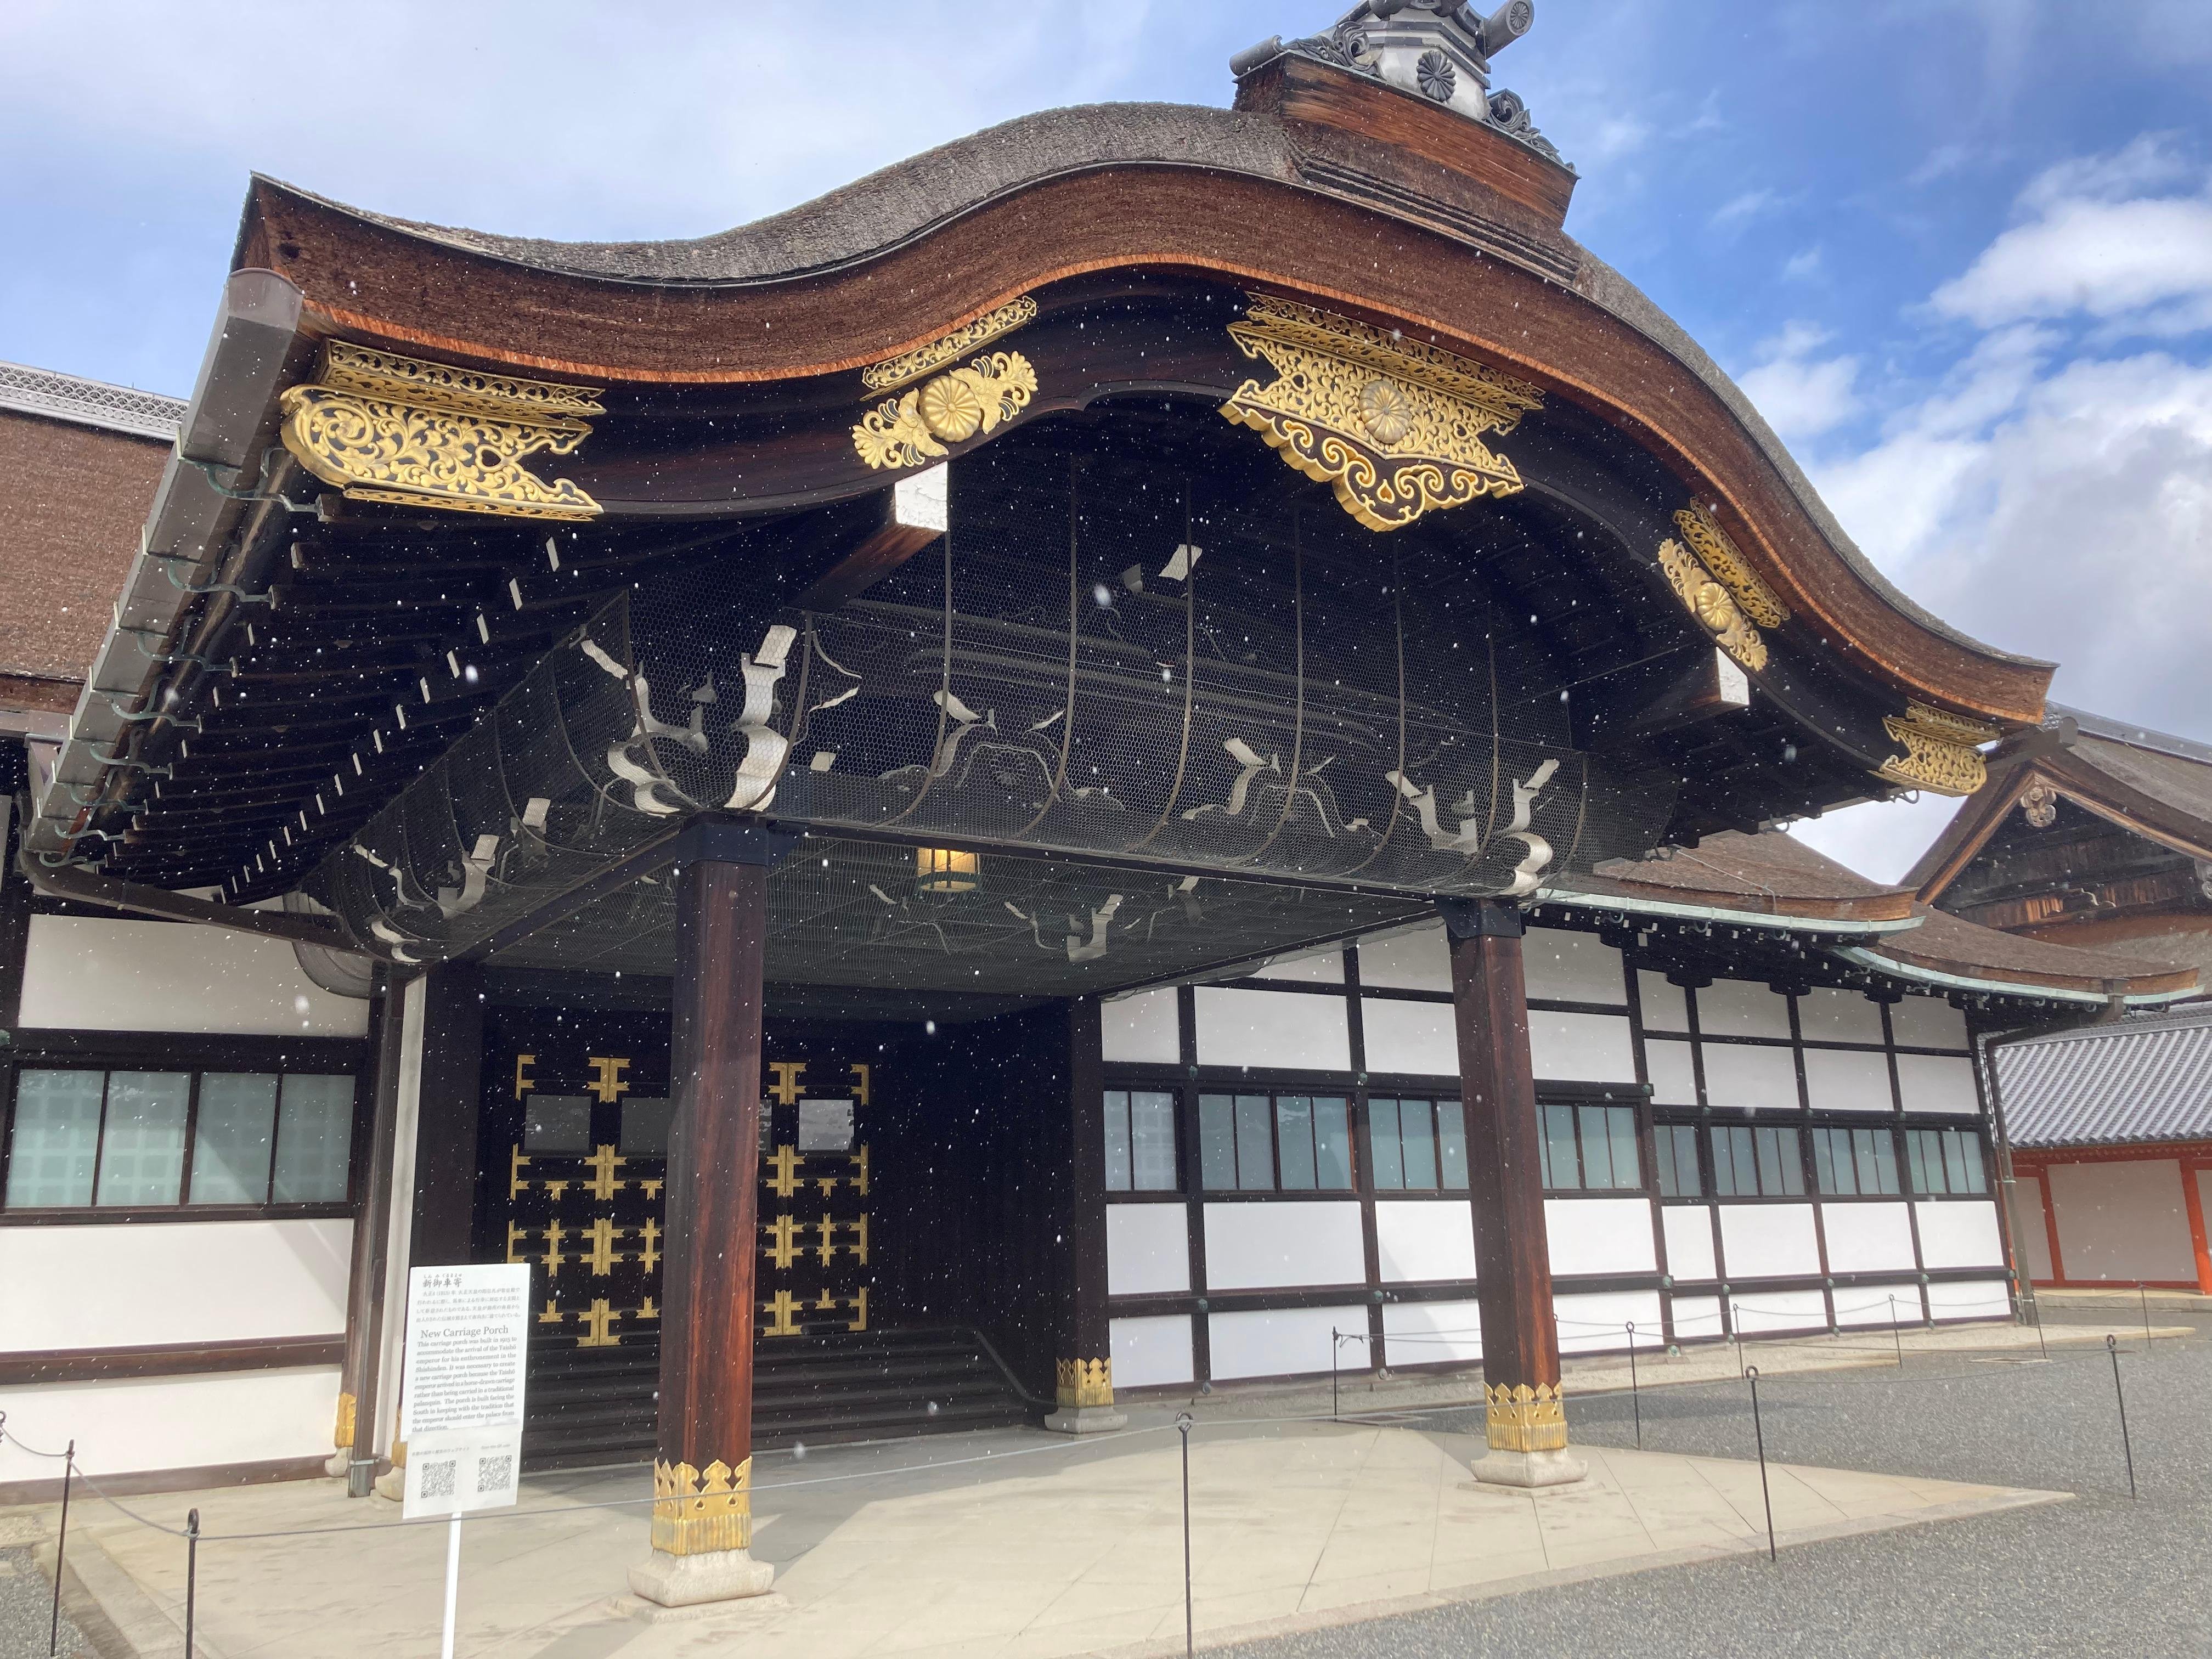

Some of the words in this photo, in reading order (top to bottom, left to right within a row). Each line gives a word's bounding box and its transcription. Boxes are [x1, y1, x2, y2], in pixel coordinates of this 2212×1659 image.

[423, 1278, 462, 1288] 新御車寄
[421, 1330, 441, 1338] New
[443, 1328, 481, 1337] Carriage
[484, 1325, 508, 1334] Porch
